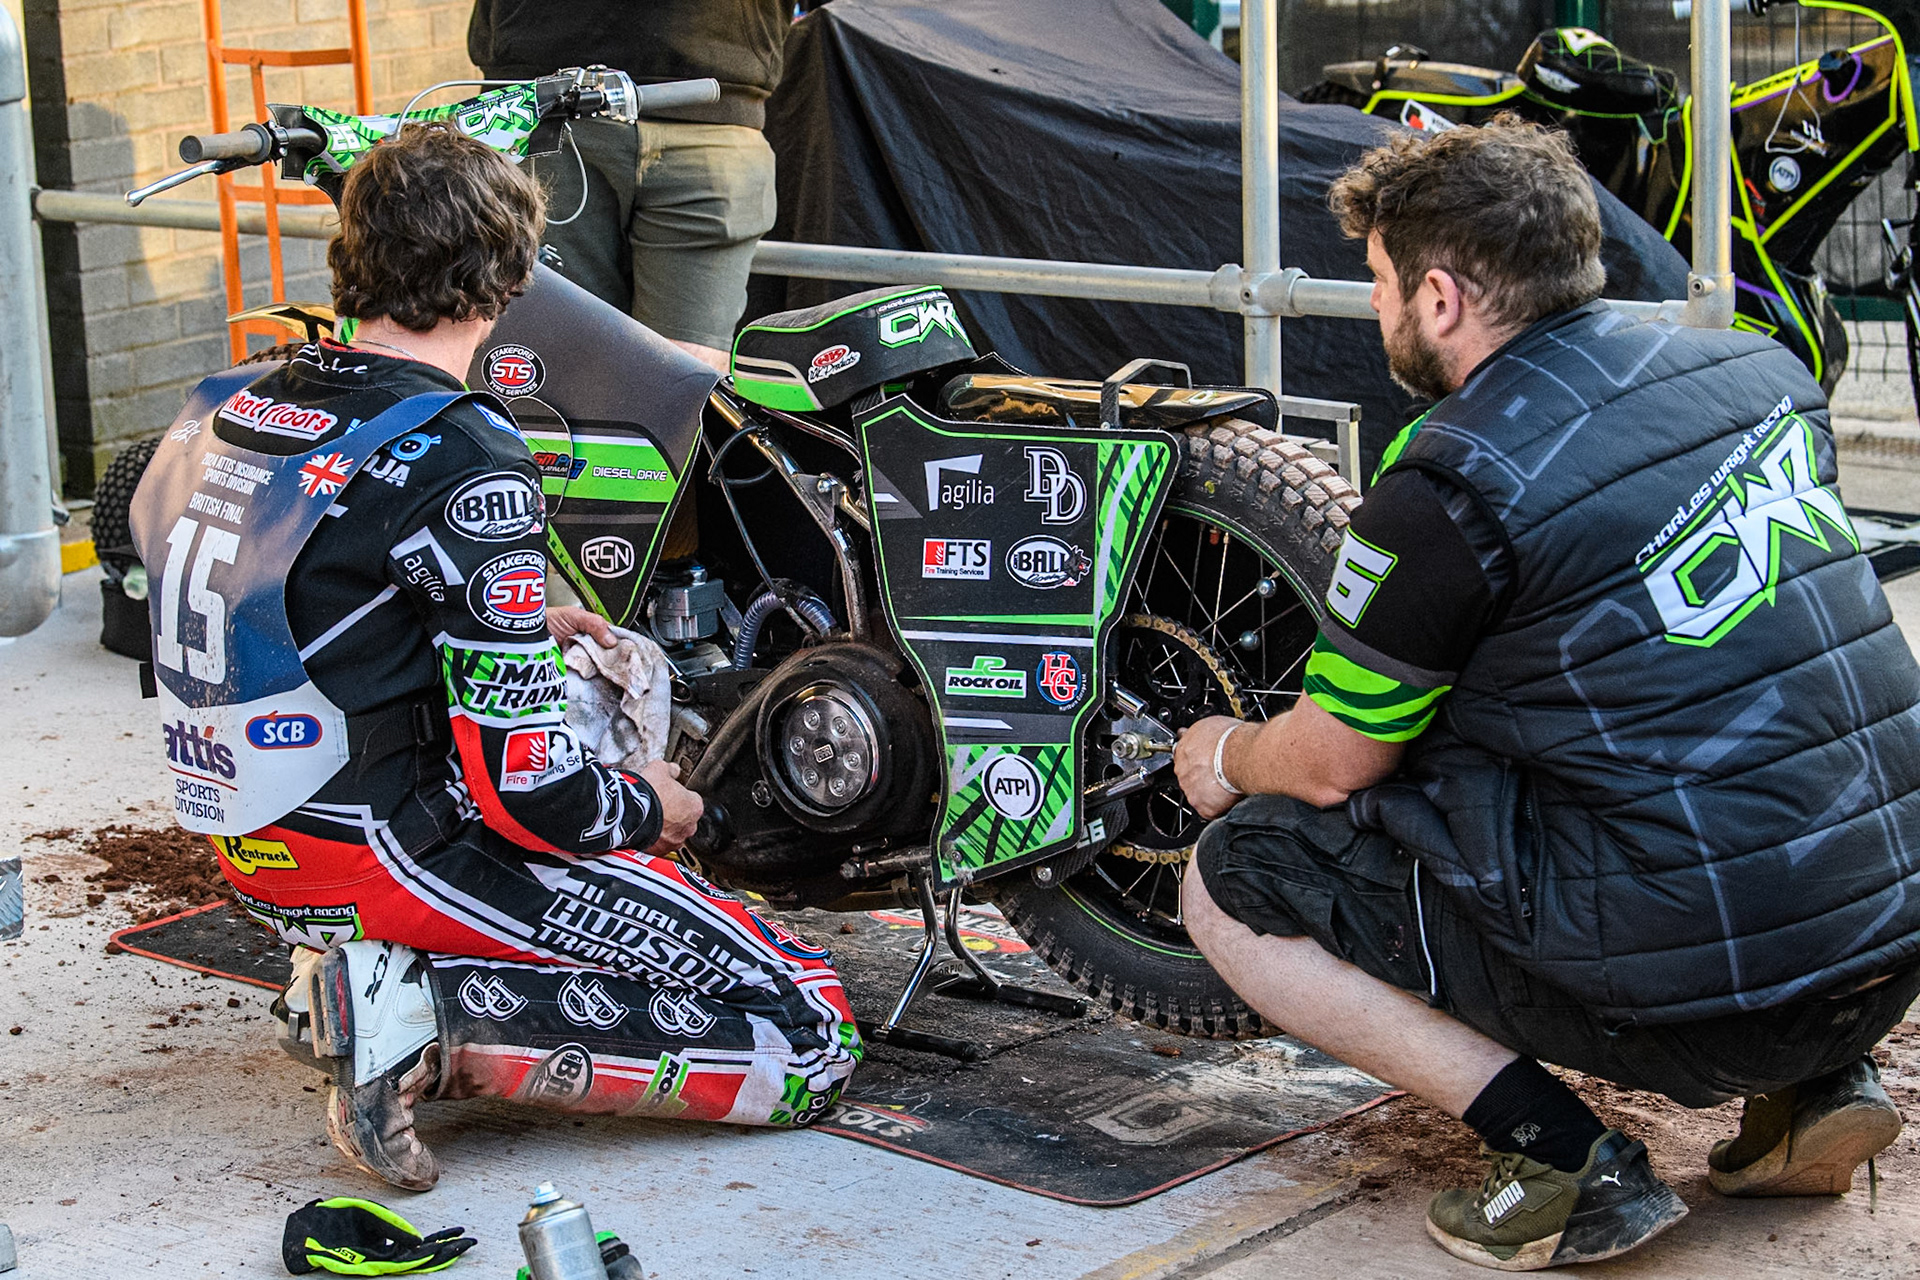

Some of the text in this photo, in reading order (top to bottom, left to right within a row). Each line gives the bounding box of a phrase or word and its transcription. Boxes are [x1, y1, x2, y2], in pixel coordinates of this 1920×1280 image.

[880, 302, 967, 346] CWR
[489, 347, 535, 362] STAKEFORD
[492, 362, 532, 380] STS
[488, 380, 538, 396] TYRE SERVICES
[259, 404, 332, 432] floors
[201, 452, 275, 486] 2024 ATTIS INSURANCE
[202, 469, 257, 496] SPORTS DIVISION
[592, 466, 636, 480] DIESEL
[636, 469, 668, 482] DAVE
[188, 492, 246, 525] BRITISH FINAL
[941, 479, 995, 510] agilia
[1643, 417, 1855, 640] CWR
[585, 541, 630, 573] RSN
[945, 541, 987, 568] FTS
[403, 555, 445, 603] agilia
[925, 566, 984, 577] Fire Training Services
[156, 516, 241, 685] 15
[488, 576, 545, 605] STS
[481, 609, 513, 629] TYRE
[948, 676, 1023, 690] ROCK OIL
[263, 720, 306, 744] SCB
[163, 719, 237, 780] attis
[505, 775, 528, 786] Fire
[994, 777, 1031, 797] ATPI
[175, 778, 225, 824] SPORTS DIVISION
[222, 835, 291, 864] Rentruck
[611, 896, 705, 949] MALC
[545, 895, 733, 995] HUDSON
[1483, 1179, 1526, 1224] PUMA
